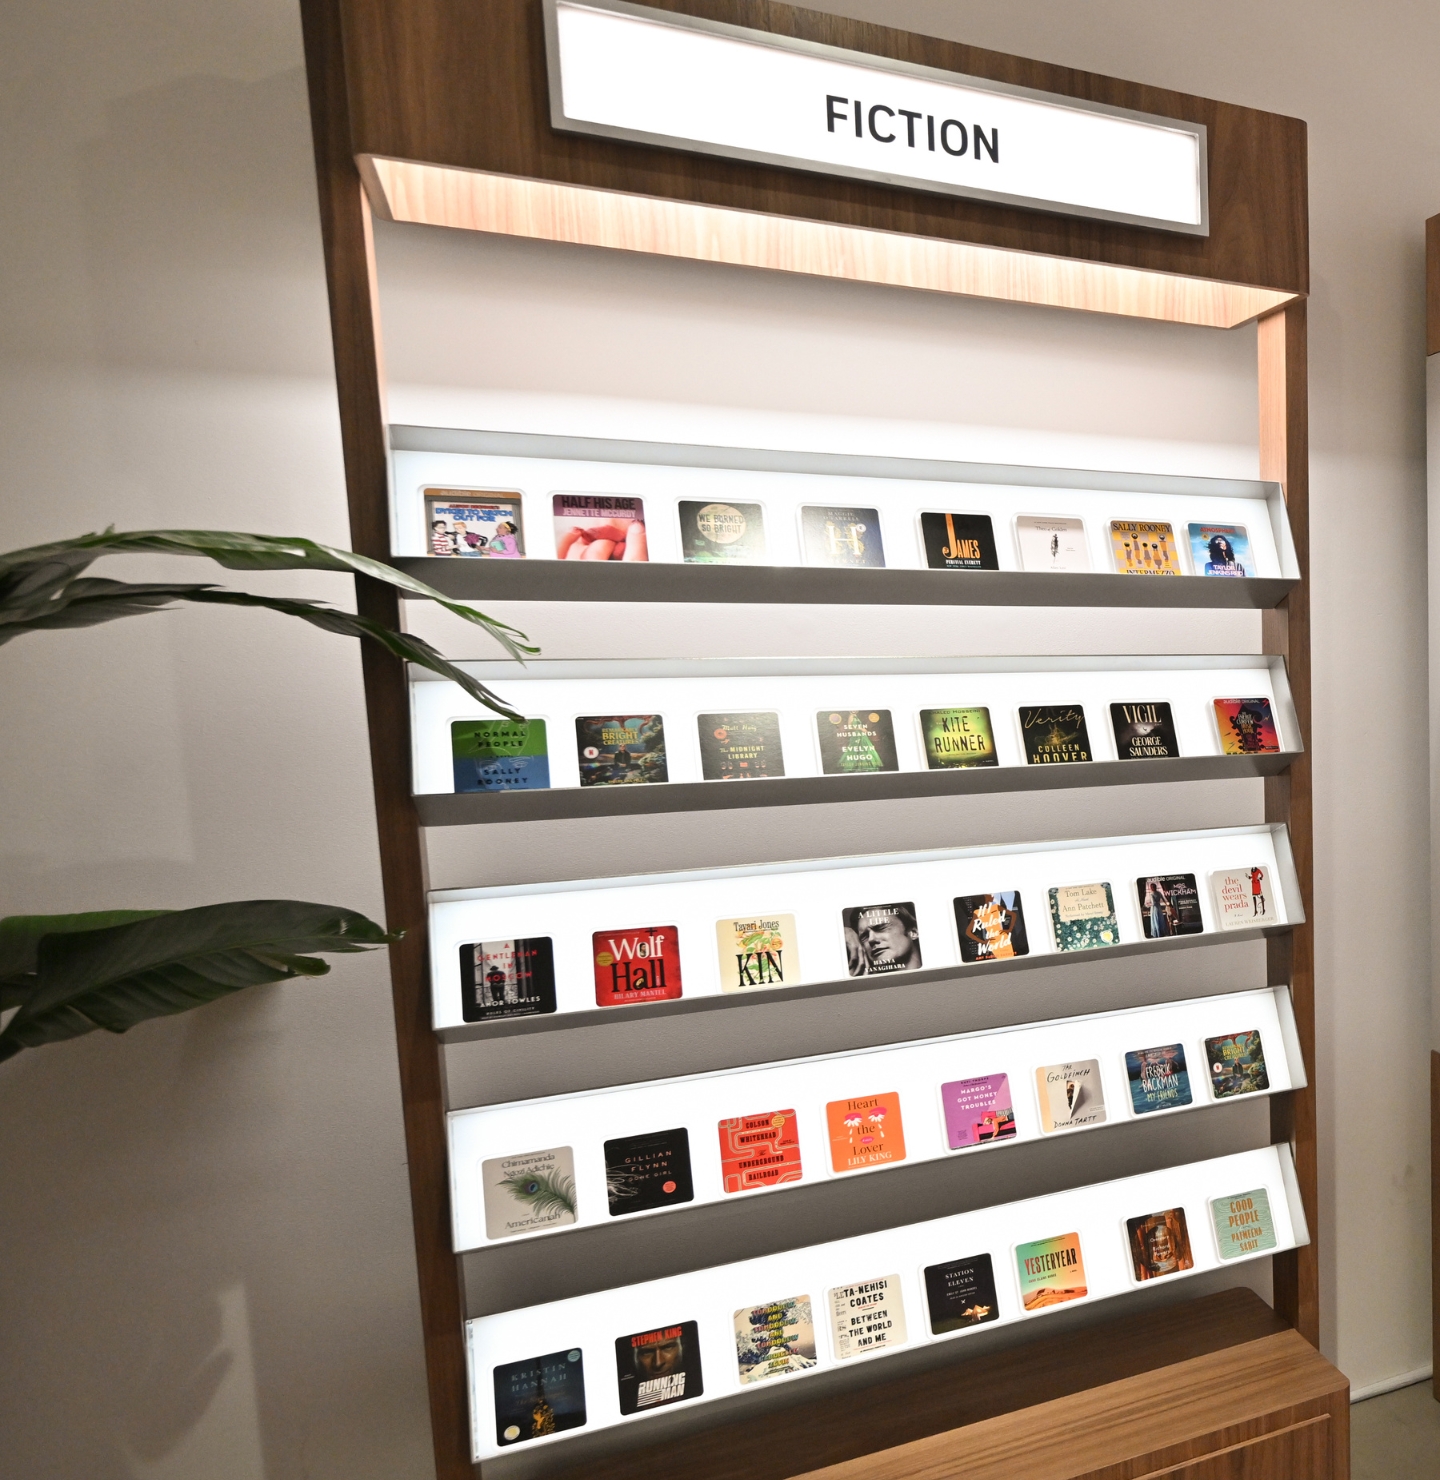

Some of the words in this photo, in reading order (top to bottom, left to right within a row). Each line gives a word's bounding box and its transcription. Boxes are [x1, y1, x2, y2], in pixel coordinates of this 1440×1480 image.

[826, 95, 999, 163] FICTION
[562, 496, 591, 508] HALF
[592, 498, 613, 509] HIS
[614, 499, 636, 510] AGE
[562, 508, 600, 517] JENNETTE
[600, 509, 636, 518] MCCURDY
[698, 513, 711, 523] WE
[701, 523, 712, 532] SO
[714, 524, 742, 534] BRIGHT
[1113, 522, 1137, 531] SALLY
[1139, 523, 1171, 533] ROONEY
[942, 513, 981, 559] JAMES
[1024, 708, 1085, 729] Verity
[1122, 704, 1162, 723] VIGIL
[941, 715, 970, 733] KITE
[474, 730, 527, 738] NORMAL
[602, 731, 639, 740] BRIGHT
[478, 740, 524, 748] PEOPLE
[934, 734, 986, 753] RUNNER
[1037, 743, 1080, 753] COLLEEN
[1131, 736, 1162, 747] GEORGE
[729, 745, 765, 753] MIDNIGHT
[841, 745, 876, 753] EVELYN
[1129, 746, 1169, 757] SAUNDERS
[727, 752, 758, 760] LIBRARY
[1032, 751, 1088, 764] HOOVER
[483, 767, 521, 776] SALLY
[477, 777, 528, 786] ROONEY
[1224, 876, 1239, 886] the
[1065, 890, 1080, 898] Tom
[1081, 887, 1097, 896] Lake
[1163, 888, 1197, 897] WICKHAM
[1222, 884, 1243, 895] devil
[1222, 893, 1248, 901] wears
[858, 911, 864, 919] A
[866, 907, 900, 918] LITTLE
[1062, 904, 1076, 913] Ann
[1077, 901, 1105, 911] Patchett
[1224, 900, 1249, 913] prada
[733, 920, 757, 934] Tayari
[758, 919, 780, 929] Jones
[868, 917, 890, 925] LIFE
[972, 909, 1006, 933] Ruled
[985, 928, 1000, 940] the
[607, 934, 665, 962] Wolf
[977, 932, 1012, 956] World
[477, 950, 538, 962] GENTLEMAN
[735, 949, 784, 987] KIN
[864, 963, 906, 973] YANAGIHARA
[485, 971, 533, 982] MOSCOW
[609, 958, 667, 992] Hall
[613, 991, 639, 1000] HILARY
[640, 989, 667, 997] MANTEL
[480, 1000, 504, 1008] AMOR
[507, 995, 541, 1004] TOWLES
[1145, 1063, 1171, 1079] FREDRIK
[960, 1084, 992, 1095] MARGO'S
[1142, 1073, 1179, 1093] BACKMAN
[973, 1091, 998, 1100] MONEY
[847, 1098, 879, 1111] Heart
[960, 1099, 997, 1111] TROUBLES
[745, 1119, 770, 1129] COLSON
[1053, 1120, 1073, 1129] DONNA
[1074, 1115, 1097, 1126] TARTT
[857, 1124, 876, 1135] the
[739, 1131, 777, 1143] WHITEHEAD
[852, 1143, 884, 1156] Lover
[501, 1153, 556, 1168] Chimamanda
[624, 1150, 672, 1164] GILLIAN
[738, 1154, 785, 1169] UNDERGROUND
[847, 1155, 867, 1166] LILY
[869, 1151, 893, 1162] KING
[630, 1161, 668, 1172] FLYNN
[628, 1173, 650, 1182] GONE
[748, 1169, 779, 1181] RAILROAD
[1229, 1197, 1254, 1214] GOOD
[504, 1211, 561, 1230] Americanah
[1228, 1209, 1260, 1227] PEOPLE
[1239, 1239, 1259, 1252] SABIT
[1023, 1247, 1078, 1276] YESTERYEAR
[944, 1267, 975, 1280] STATION
[947, 1276, 974, 1287] ELEVEN
[843, 1280, 888, 1298] TA-NEHISI
[849, 1292, 885, 1308] COATES
[850, 1309, 888, 1326] BETWEEN
[848, 1327, 864, 1338] THE
[866, 1320, 893, 1333] WORLD
[631, 1330, 663, 1348] STEPHEN
[664, 1325, 683, 1340] KING
[857, 1336, 873, 1347] AND
[874, 1333, 887, 1343] ME
[511, 1362, 566, 1381] KRISTIN
[511, 1373, 567, 1392] HANNAH
[638, 1371, 687, 1395] RUNNING
[660, 1383, 686, 1401] MAN
